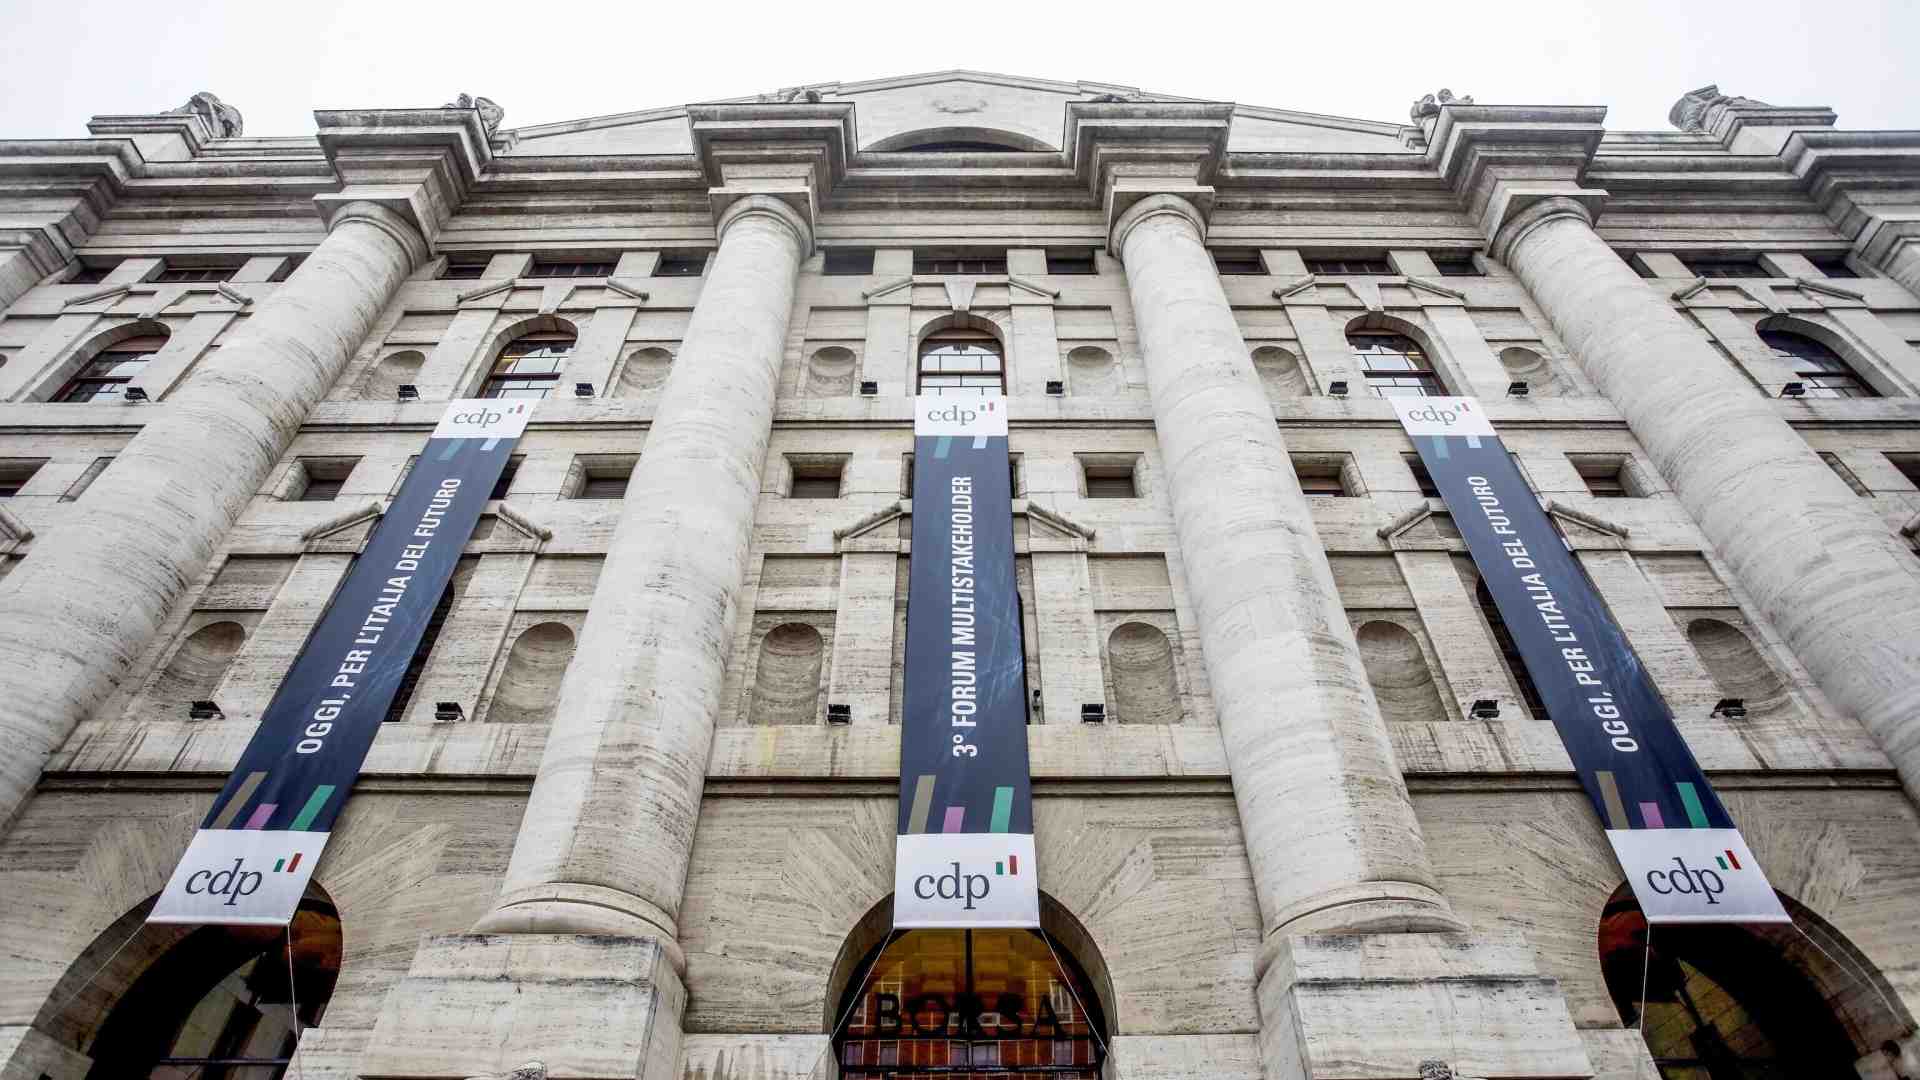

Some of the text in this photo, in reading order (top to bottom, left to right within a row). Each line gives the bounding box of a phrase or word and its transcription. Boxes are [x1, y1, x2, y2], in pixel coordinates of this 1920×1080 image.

[453, 407, 501, 429] cdp
[928, 405, 976, 426] cdp
[1408, 405, 1457, 426] cdp
[296, 478, 462, 754] OGGI, PER L'ITALIA DEL FUTURO
[951, 476, 978, 758] 3° FORUM MULTISTAKEHOLDER
[1467, 476, 1639, 752] OGGI, PER L'ITALIA DEL FUTURO
[184, 858, 262, 906] cdp
[914, 862, 990, 910] cdp
[1646, 857, 1725, 904] cdp
